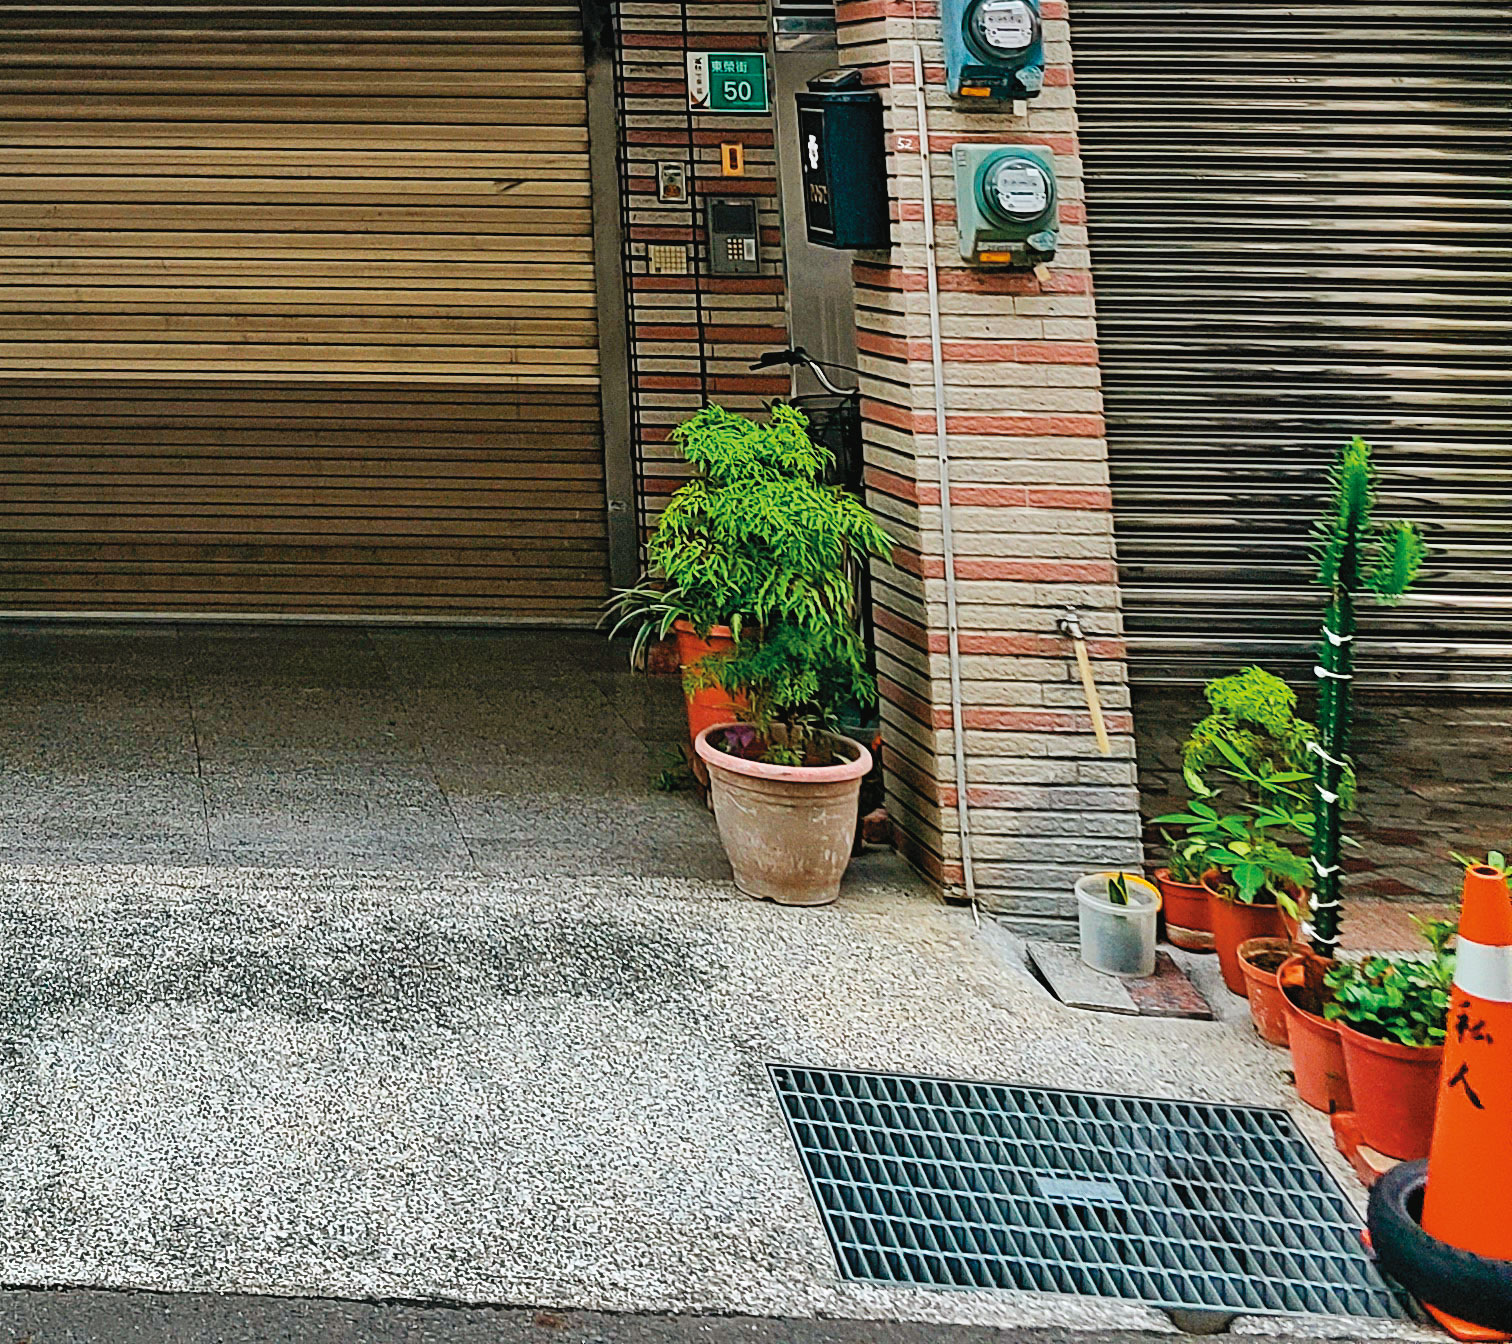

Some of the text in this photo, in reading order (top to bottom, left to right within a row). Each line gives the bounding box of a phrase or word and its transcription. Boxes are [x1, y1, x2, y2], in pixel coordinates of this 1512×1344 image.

[711, 60, 747, 73] 東榮街
[723, 80, 752, 101] 50
[896, 137, 913, 150] 52
[1447, 1001, 1495, 1110] 私人
